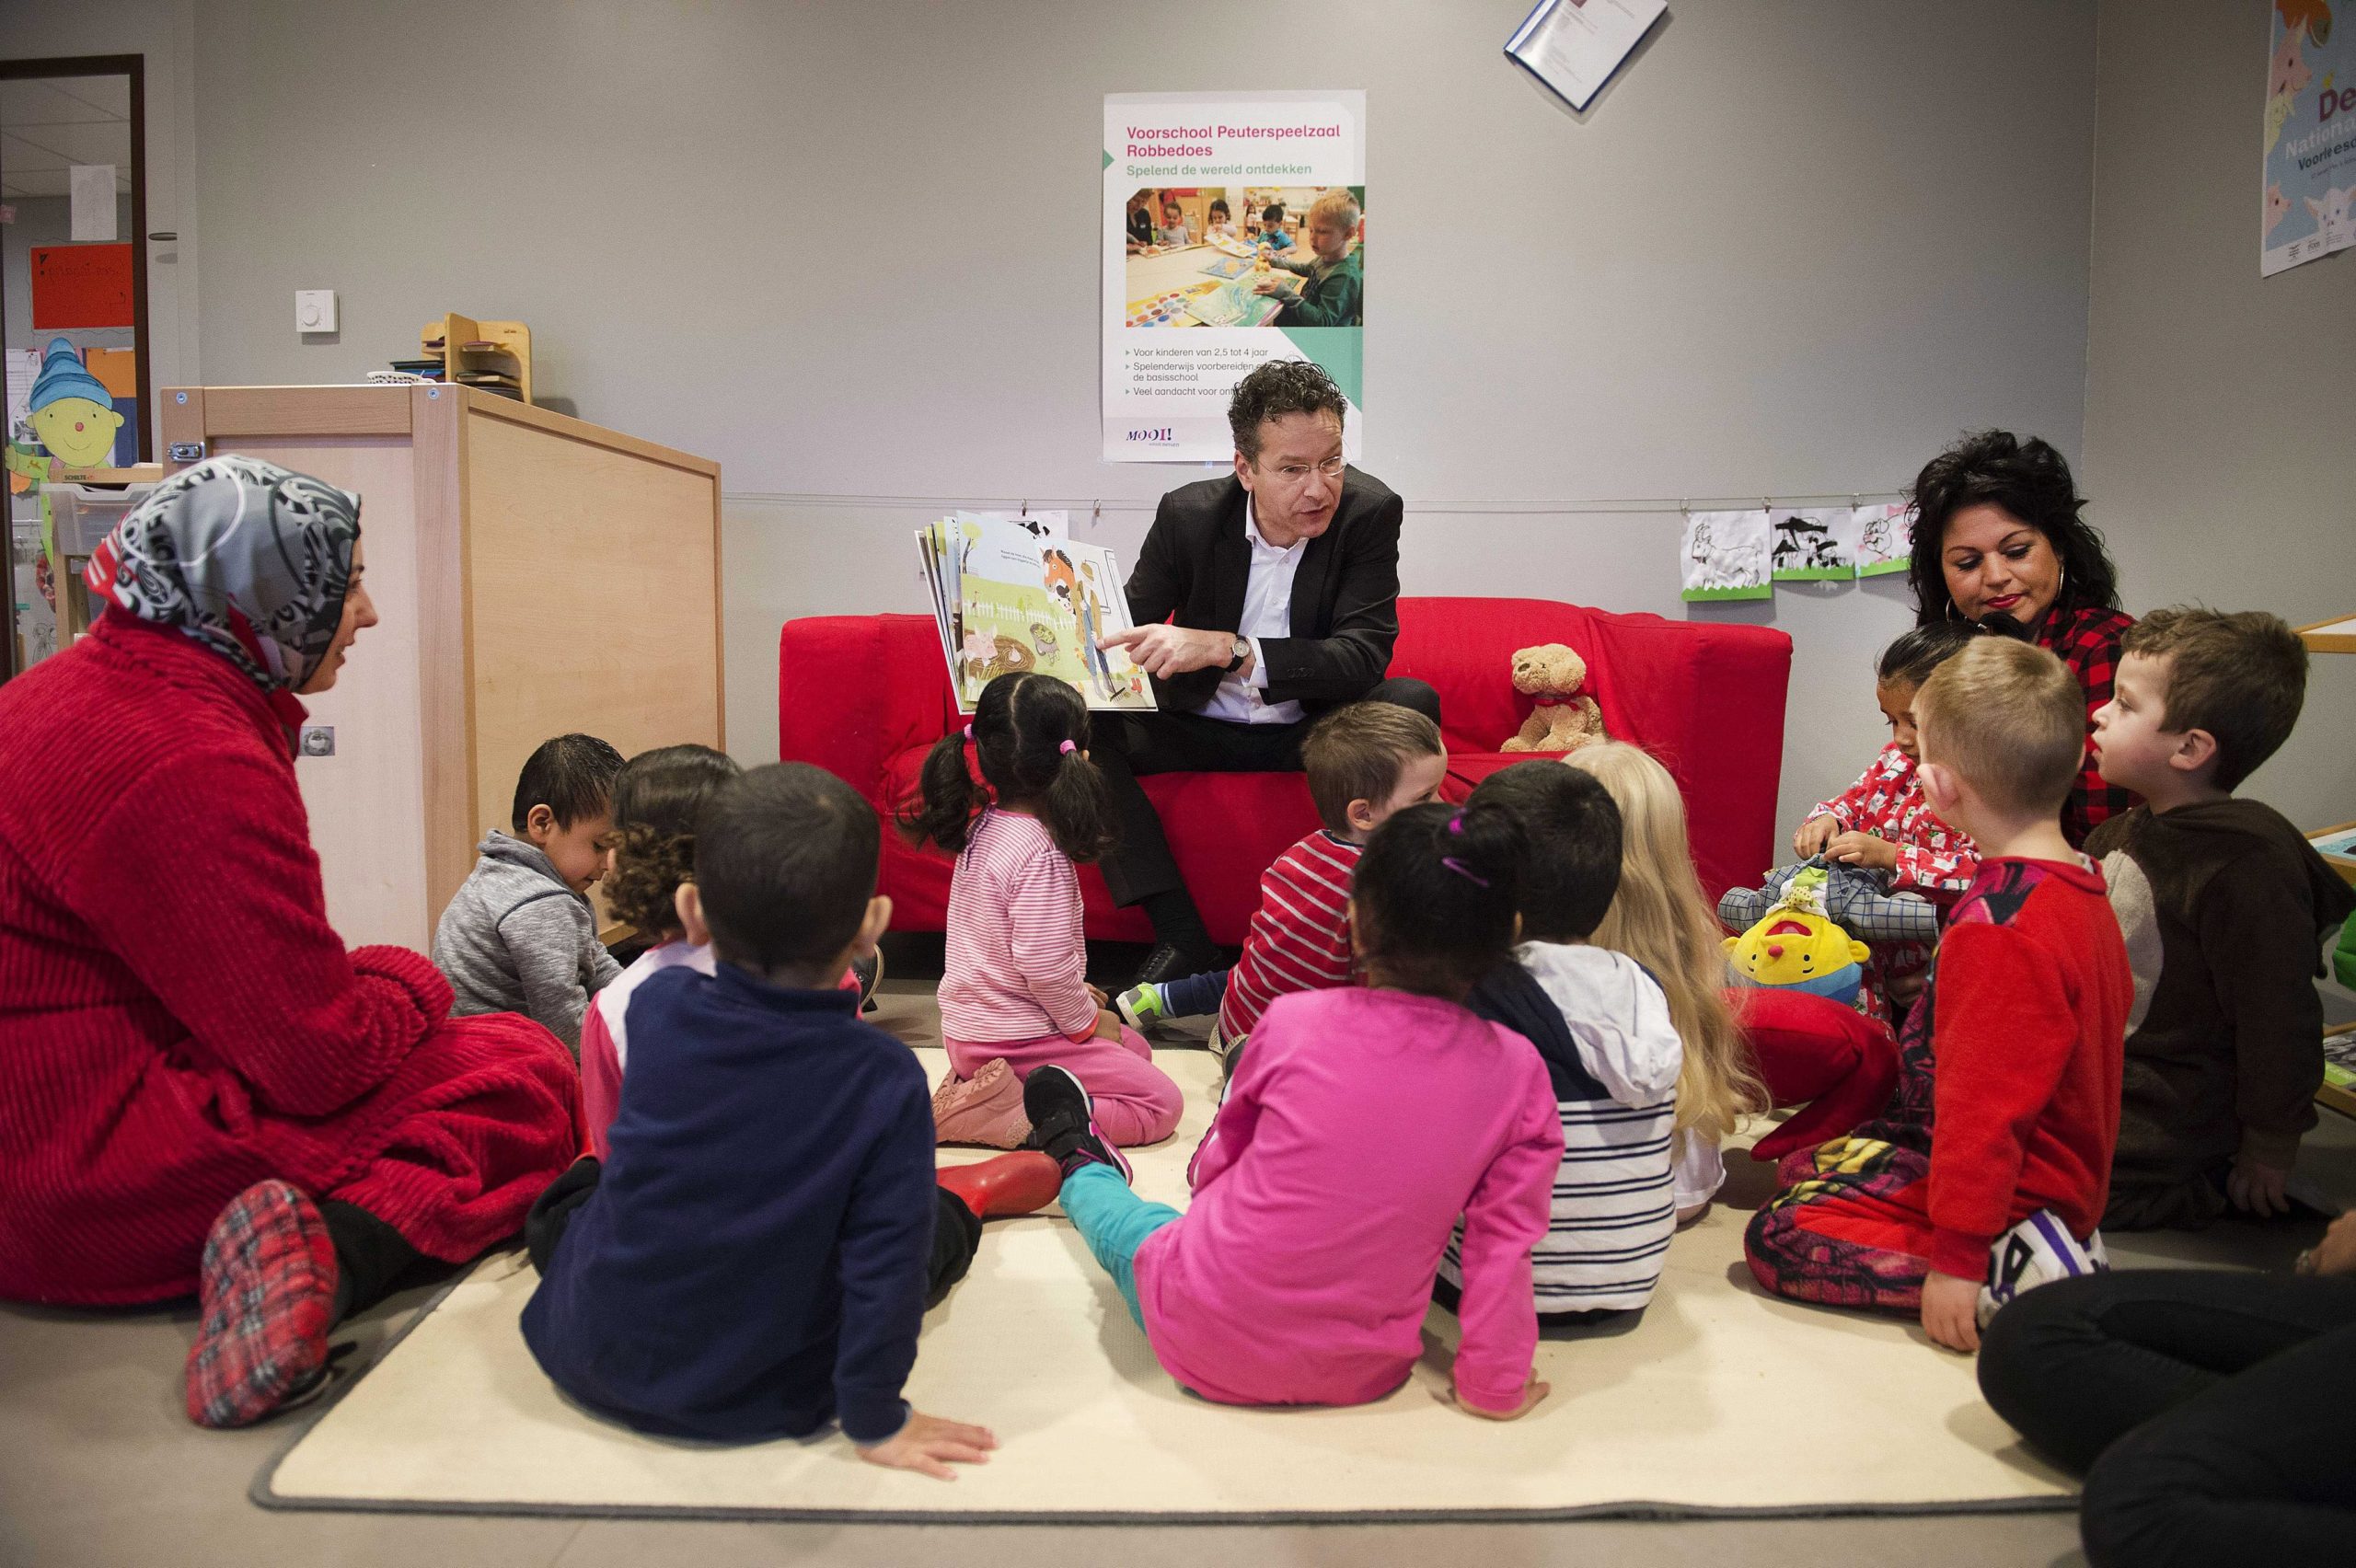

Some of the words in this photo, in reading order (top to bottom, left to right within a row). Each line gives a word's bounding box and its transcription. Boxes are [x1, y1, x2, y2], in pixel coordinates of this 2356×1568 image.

[1126, 126, 1213, 139] Voorschool
[1218, 125, 1341, 140] Peuterspeelzaal
[1126, 144, 1213, 156] Robbedoes
[1126, 165, 1178, 179] Spelend
[1182, 165, 1196, 175] de
[1200, 164, 1242, 175] wereld
[1245, 164, 1312, 175] ontdekken
[1133, 348, 1153, 357] Voor
[1155, 348, 1194, 357] kinderen
[1214, 348, 1229, 358] 2,5
[1230, 348, 1242, 356] tot
[1243, 348, 1250, 356] 4
[1251, 348, 1269, 358] jaar
[1133, 362, 1195, 372] Spelenderwijs
[1196, 362, 1254, 371] voorbereiden
[1133, 373, 1144, 382] de
[1146, 373, 1198, 382] basisschool
[1133, 386, 1152, 396] Veel
[1154, 386, 1195, 396] aandacht
[1197, 387, 1218, 396] voor
